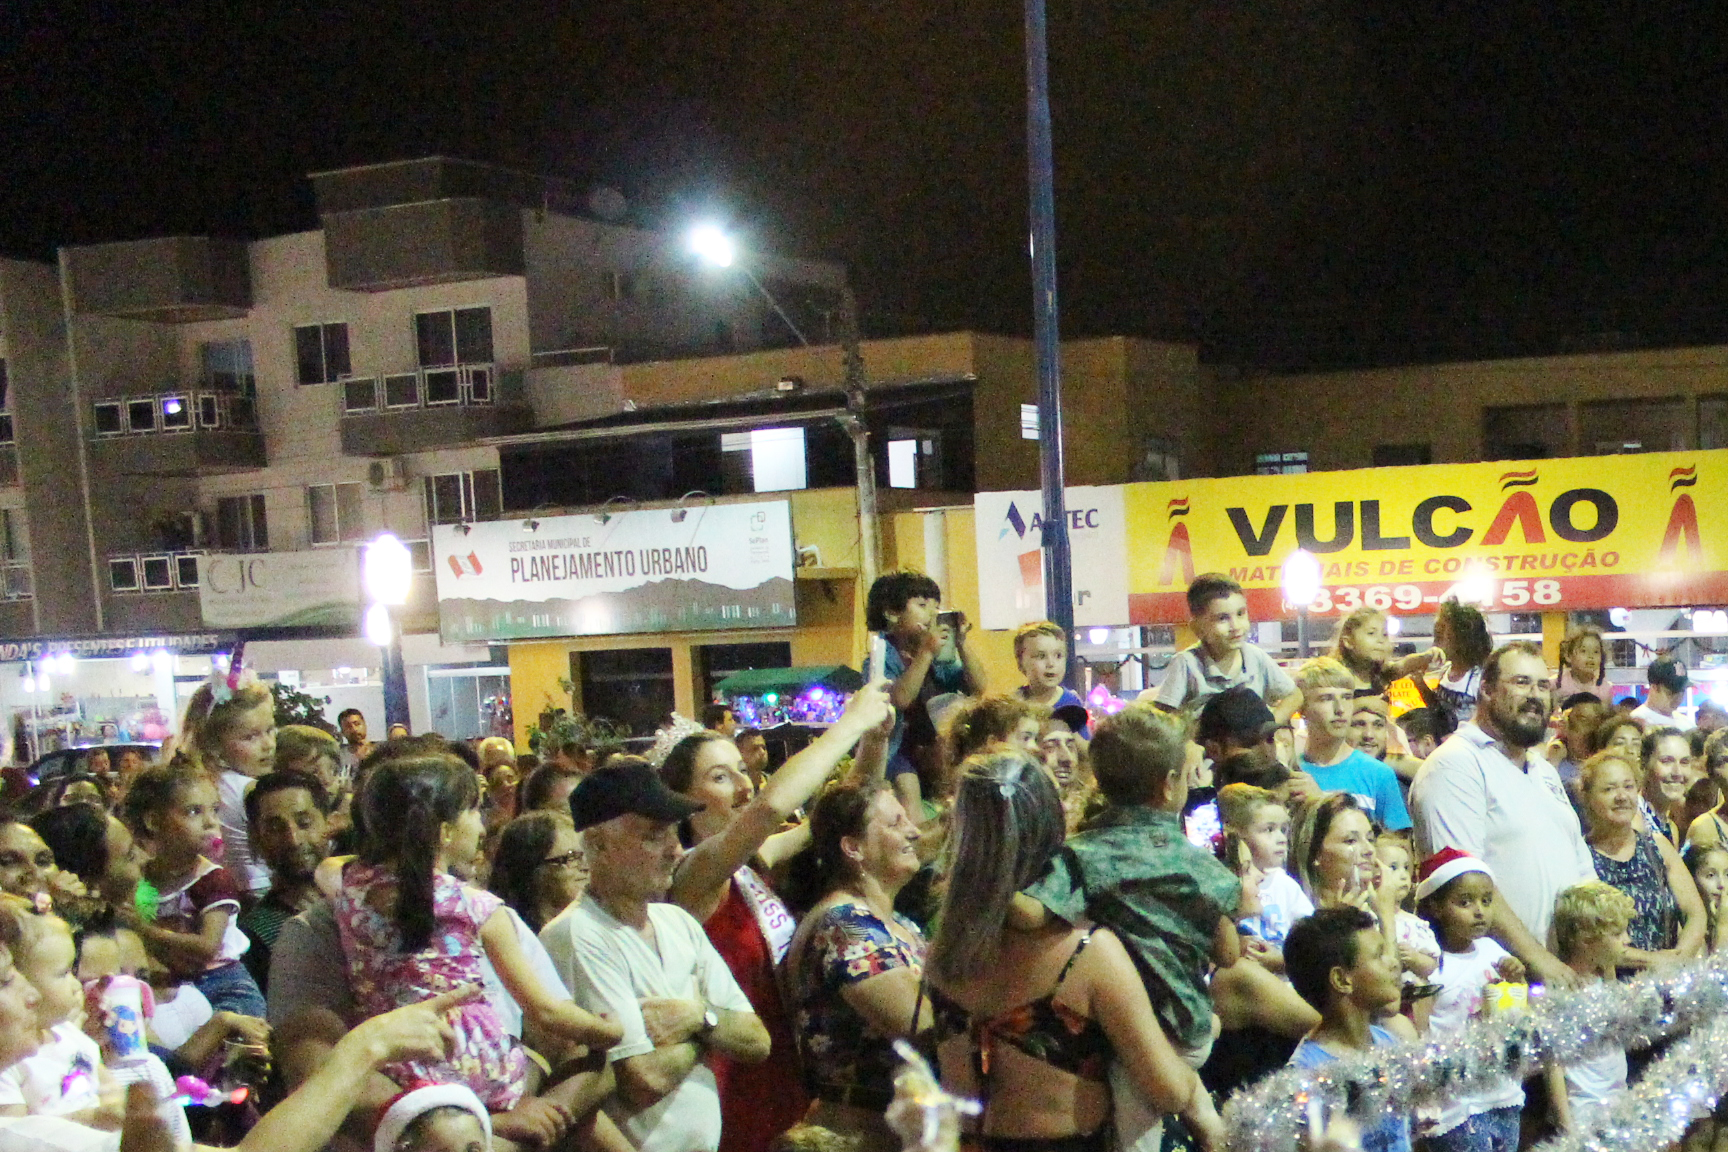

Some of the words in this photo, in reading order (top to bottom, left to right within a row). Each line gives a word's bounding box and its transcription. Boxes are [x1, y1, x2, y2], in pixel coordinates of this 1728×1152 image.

[1226, 467, 1619, 557] VULCÃO
[508, 540, 545, 553] SECRETARIA
[546, 538, 580, 550] MUNICIPAL
[582, 537, 591, 548] DE
[510, 550, 635, 583] PLANEJAMENTO
[640, 546, 708, 576] URBANO
[1379, 559, 1414, 576] DE
